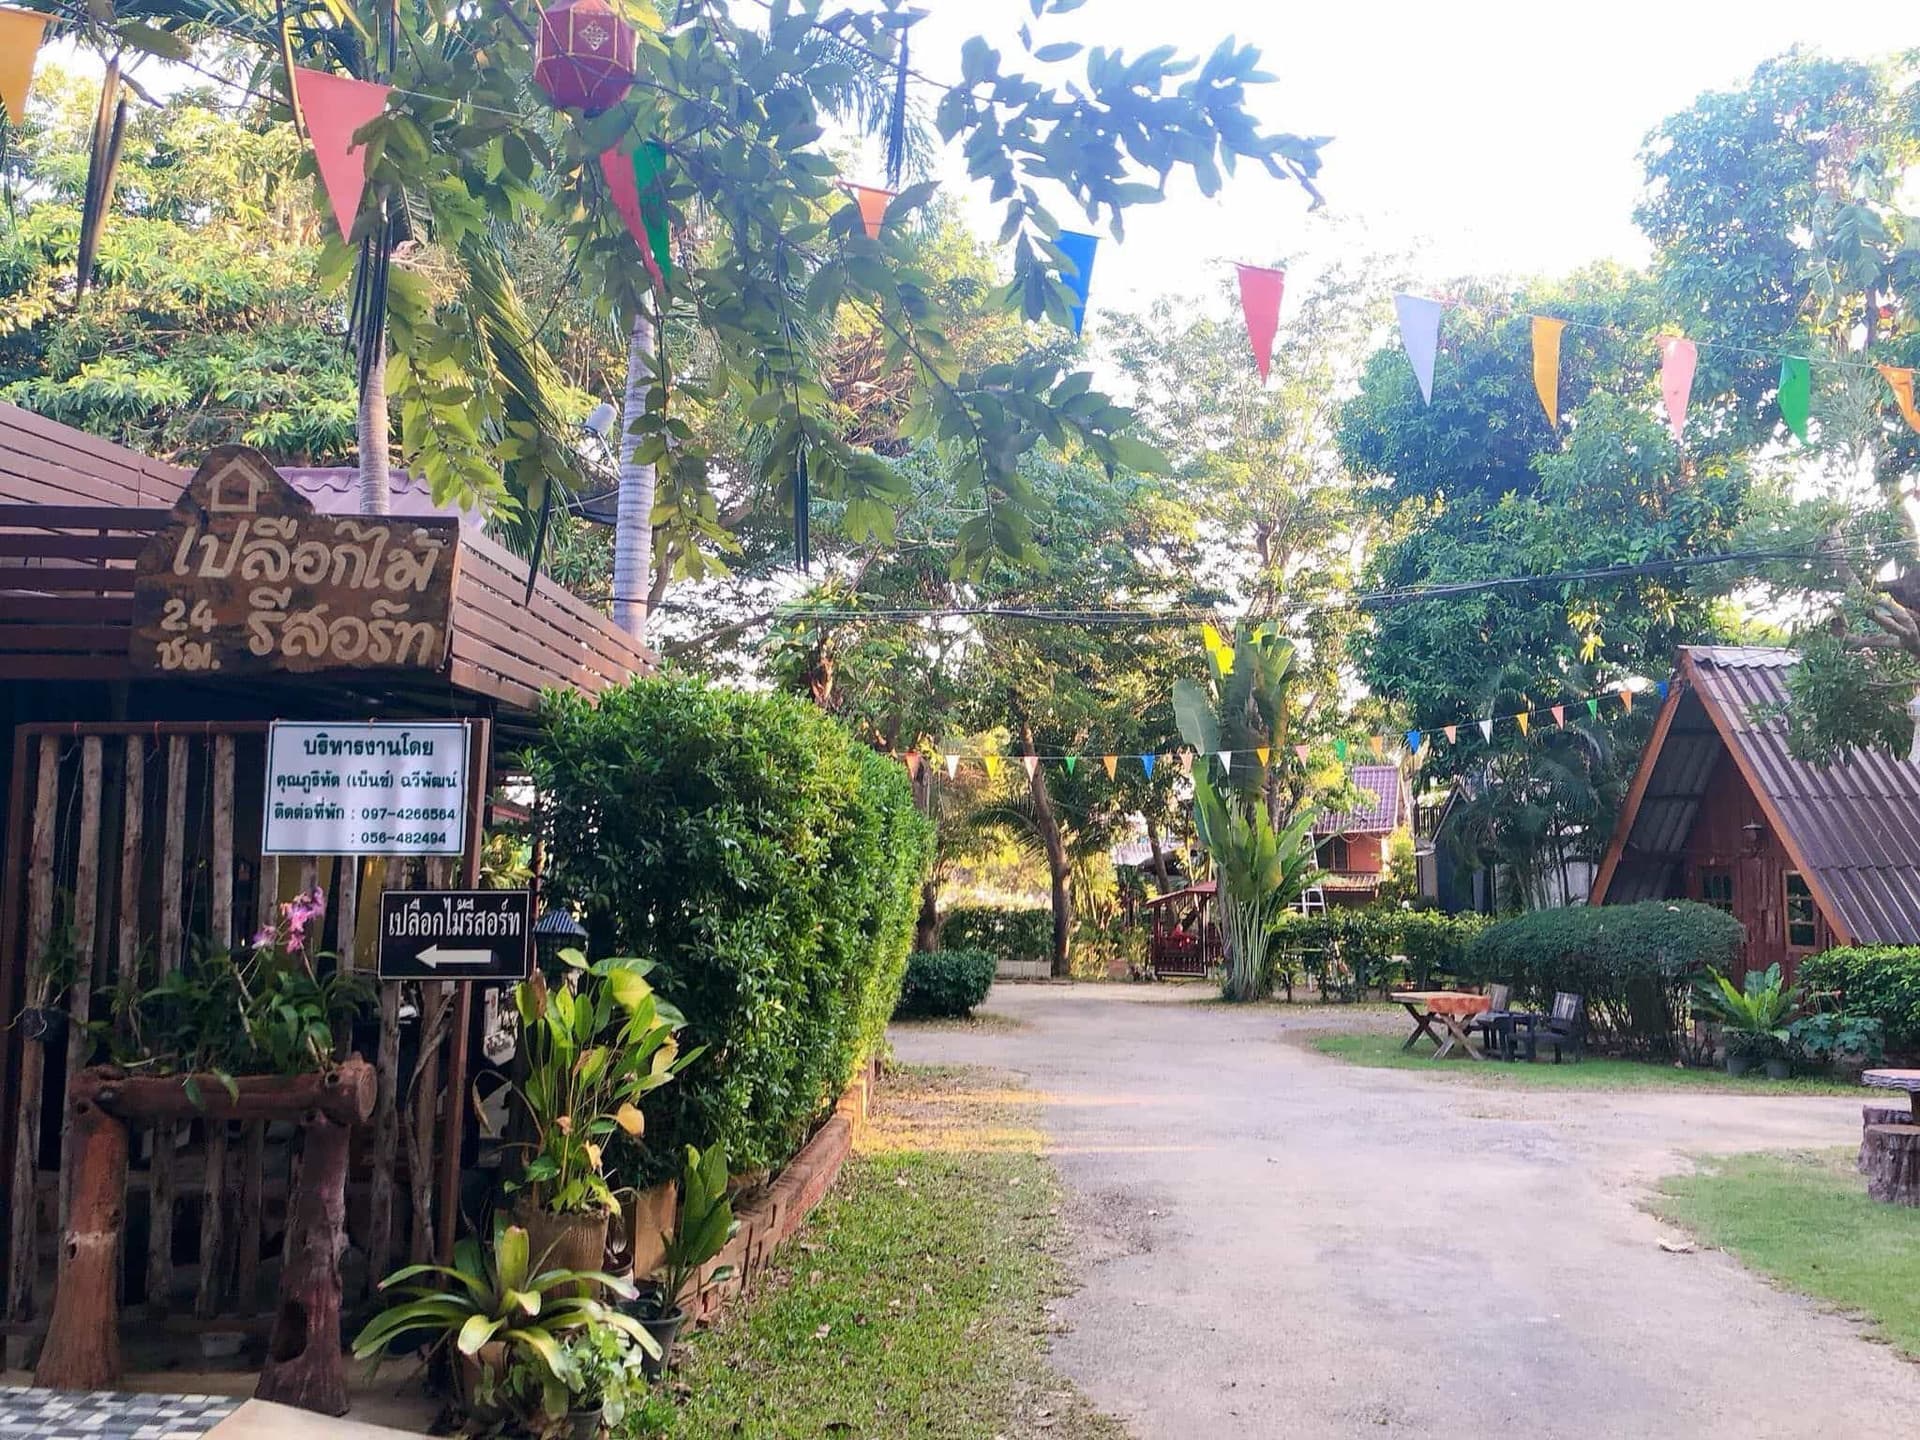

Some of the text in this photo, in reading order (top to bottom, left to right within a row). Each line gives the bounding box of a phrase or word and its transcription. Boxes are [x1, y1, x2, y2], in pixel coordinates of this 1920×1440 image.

[173, 516, 446, 592] เปลือกไม้
[160, 598, 218, 634] 24
[246, 586, 436, 666] รีสอร์ท
[156, 636, 221, 671] ชม.
[304, 731, 434, 757] บริหารงานโดย
[274, 796, 345, 821] ติดต่อที่พัก
[388, 896, 520, 938] เปลือกไม้รีสอร์ท
